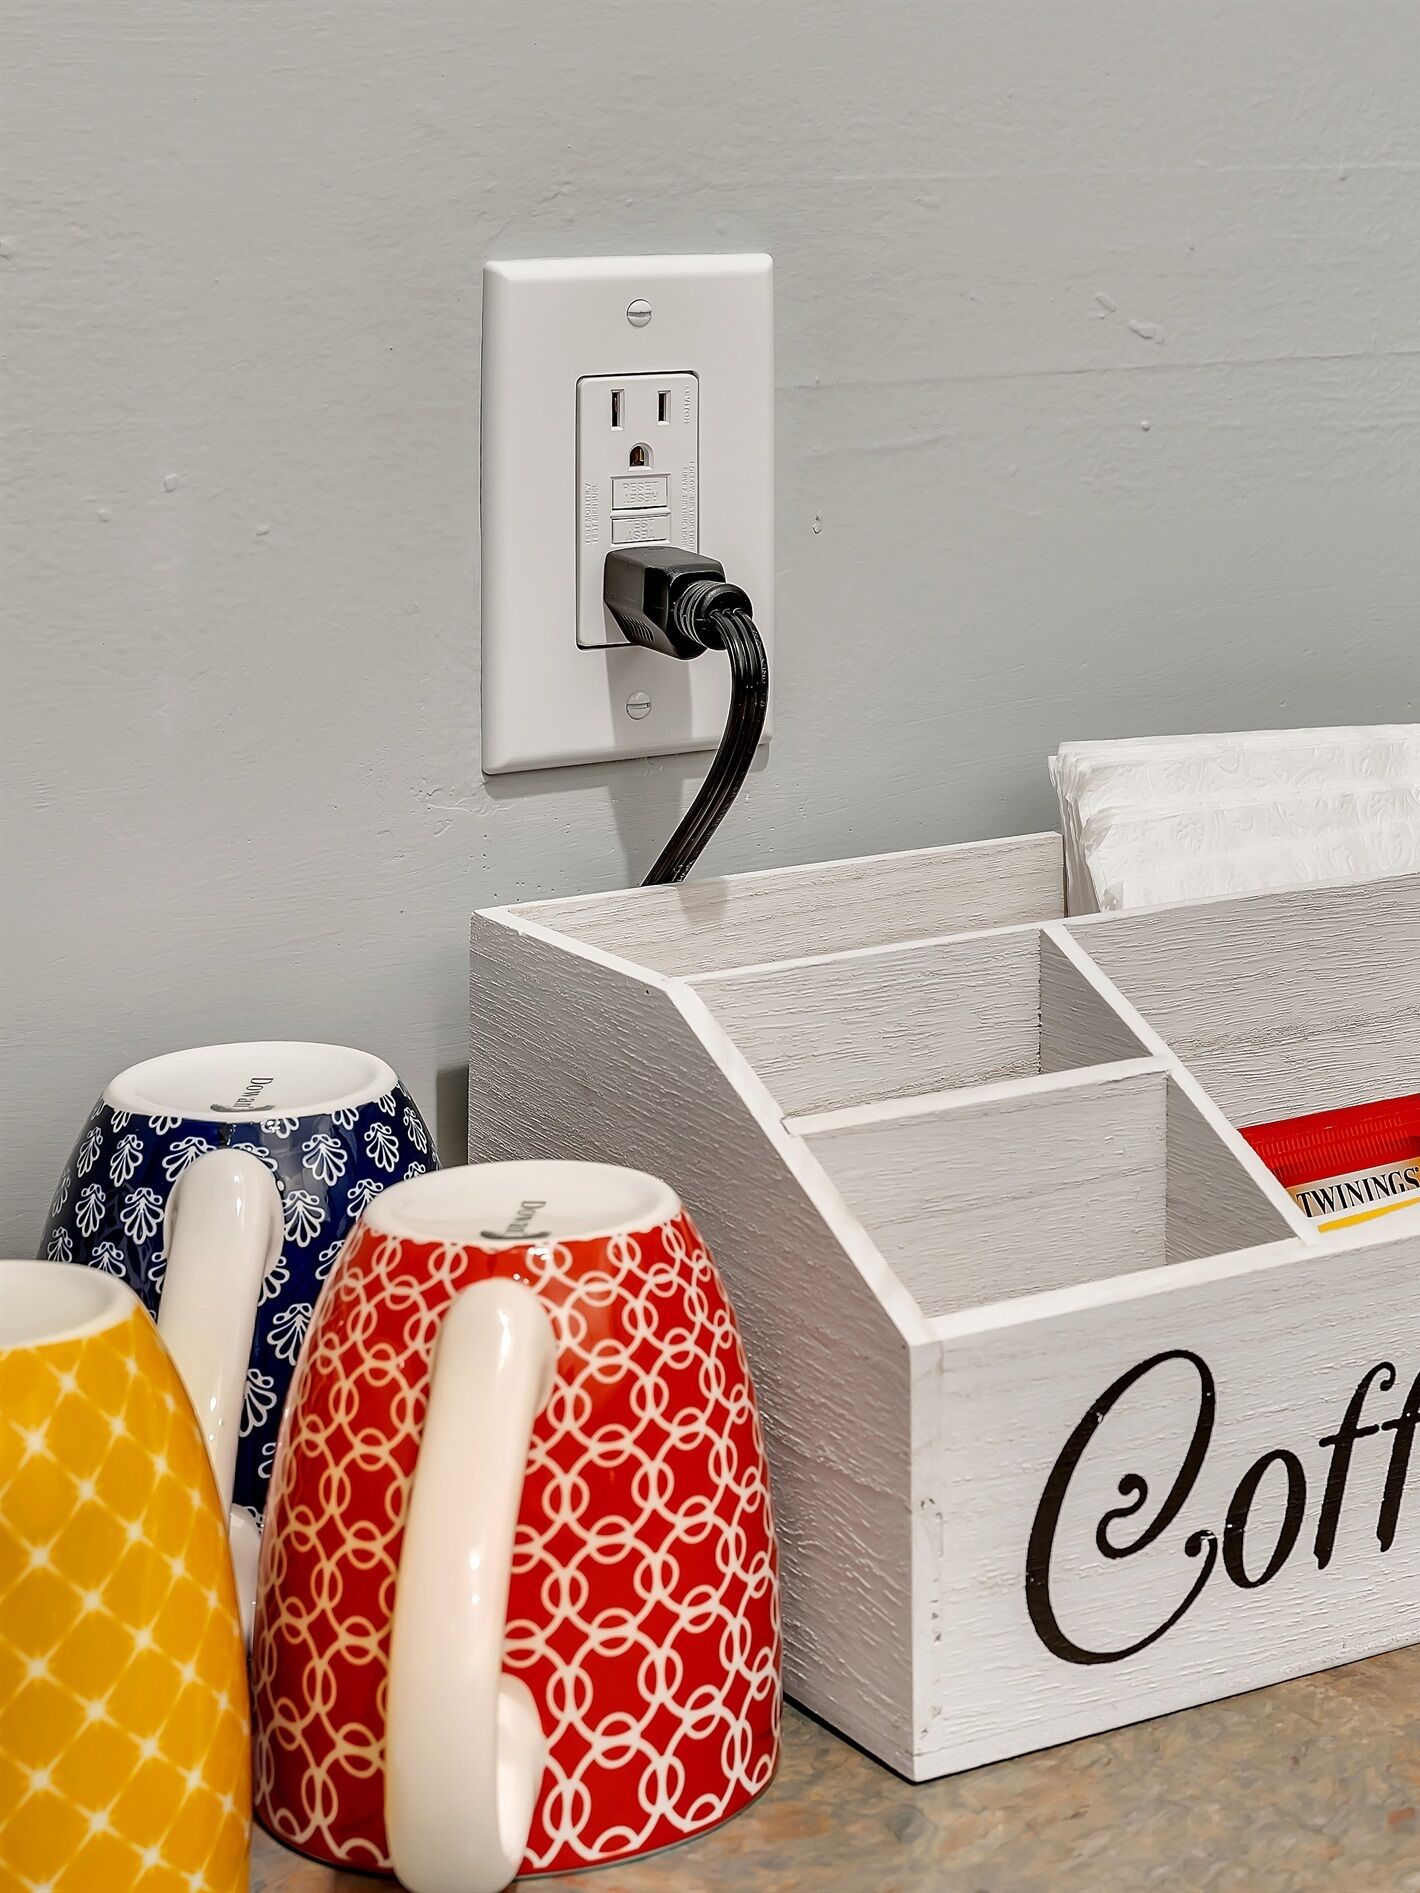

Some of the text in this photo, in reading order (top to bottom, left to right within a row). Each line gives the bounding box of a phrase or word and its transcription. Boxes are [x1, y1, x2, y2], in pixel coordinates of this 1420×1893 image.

[622, 481, 659, 491] RESET
[591, 523, 599, 543] TEST
[233, 1078, 273, 1108] Dowan
[1296, 1167, 1420, 1218] TWININGS
